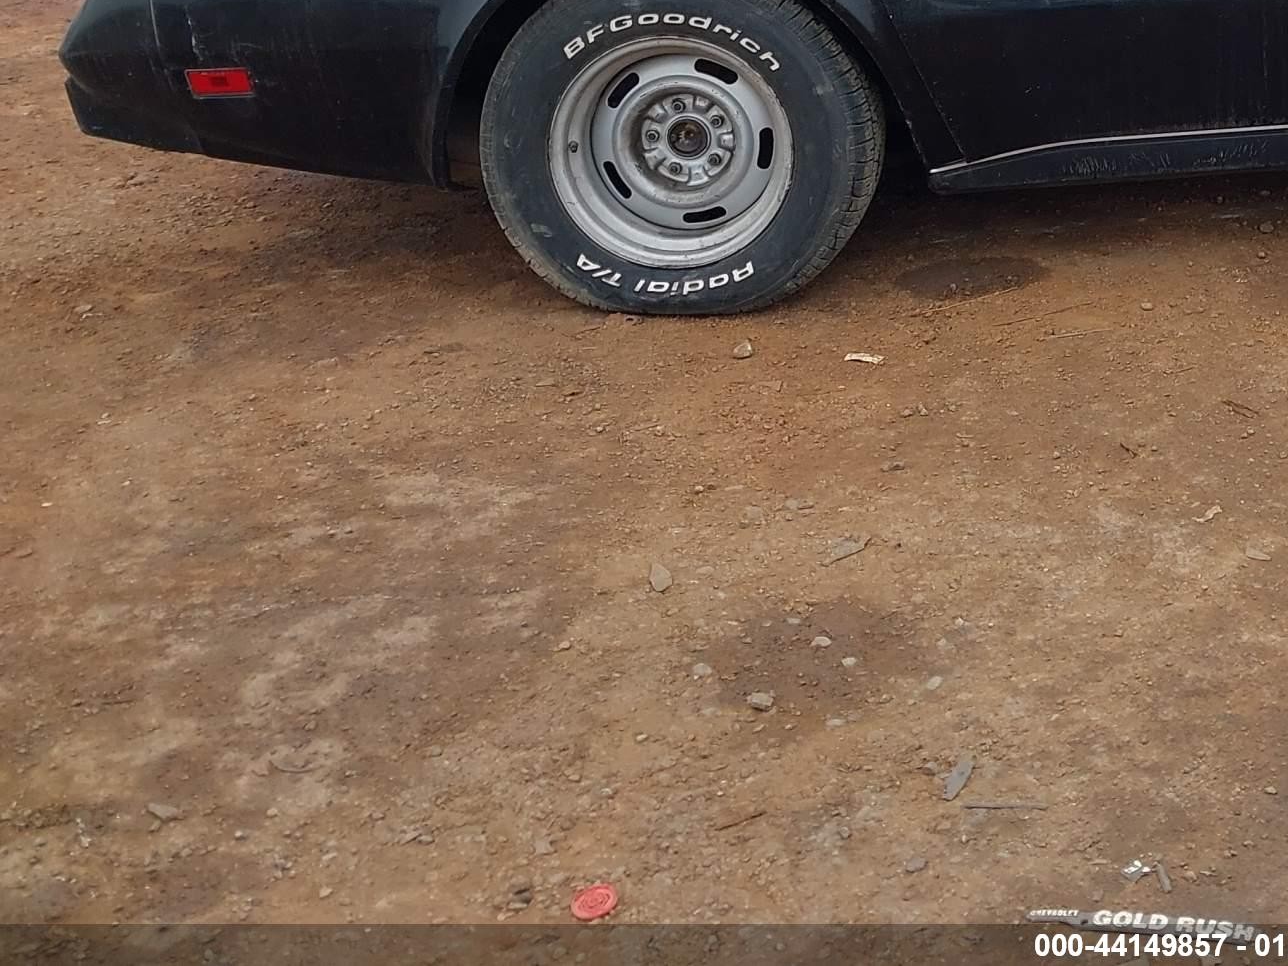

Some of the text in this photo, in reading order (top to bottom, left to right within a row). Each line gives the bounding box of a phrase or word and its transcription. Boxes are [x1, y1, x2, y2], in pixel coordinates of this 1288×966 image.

[562, 12, 782, 72] BFGoodrich
[576, 252, 755, 296] Radial T/A
[1092, 909, 1256, 942] GOLD RUSH
